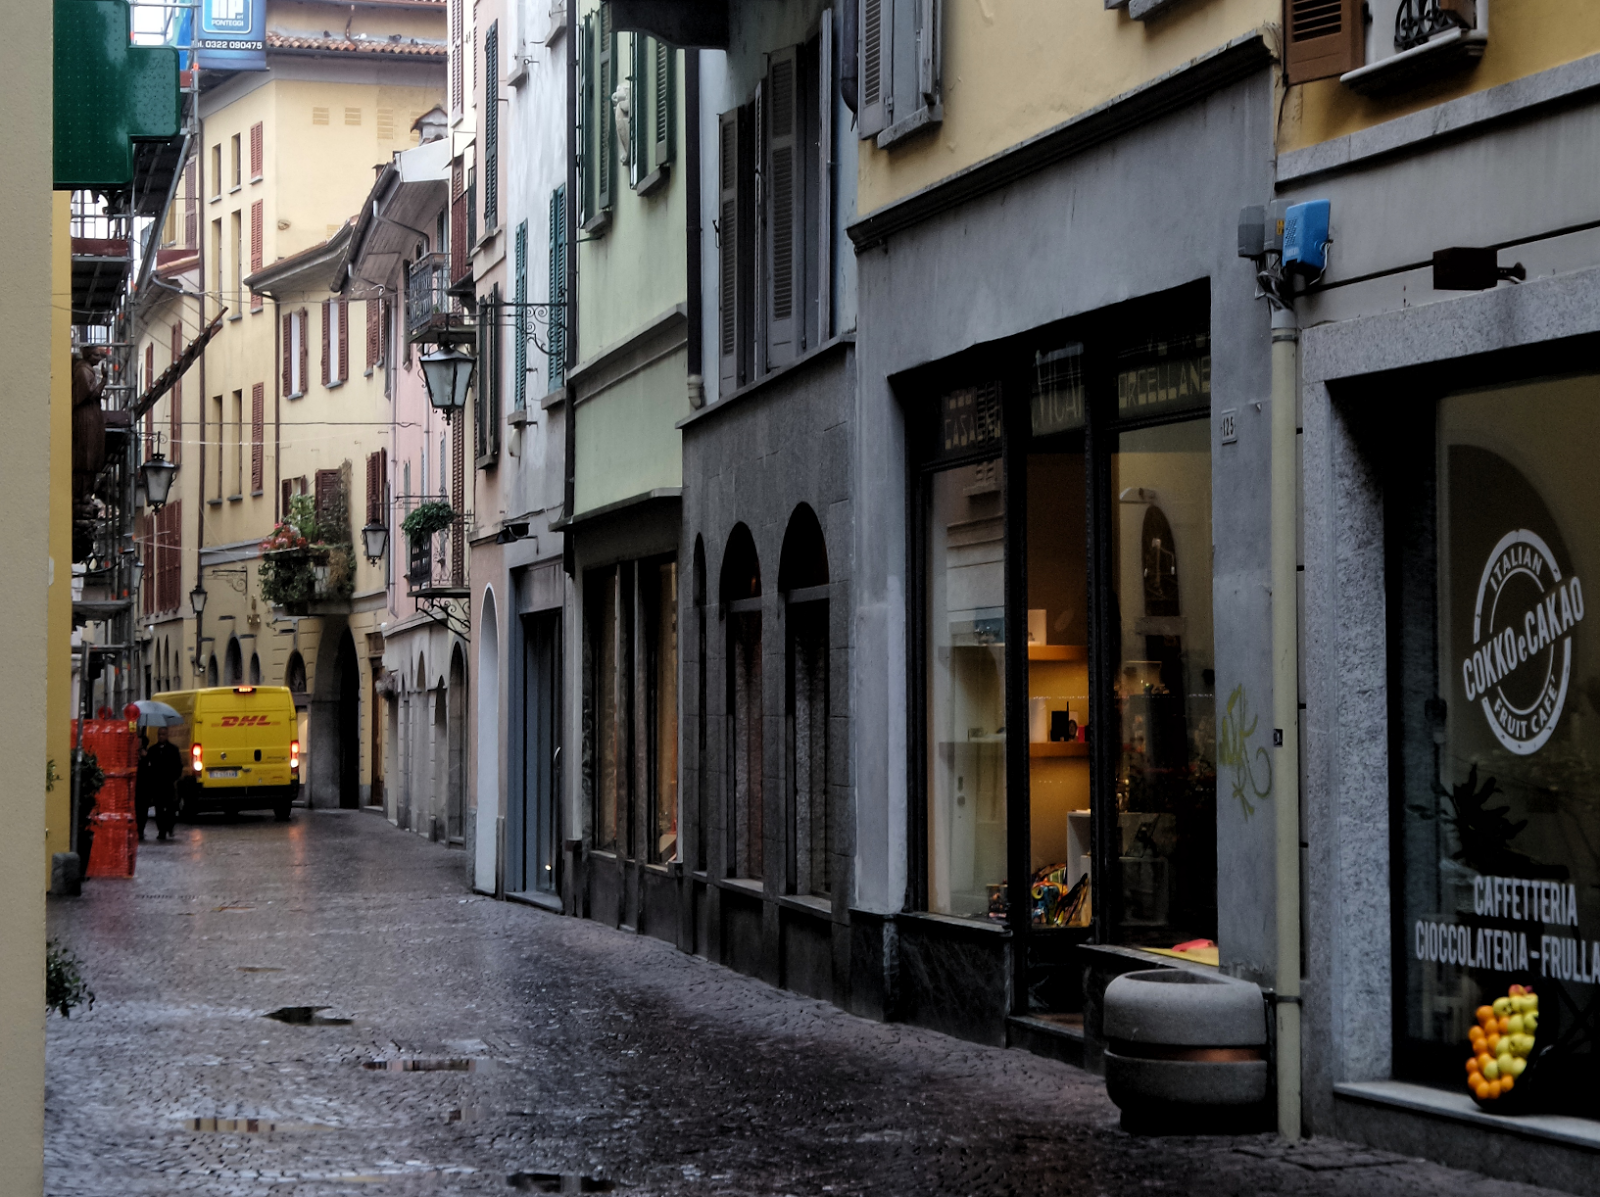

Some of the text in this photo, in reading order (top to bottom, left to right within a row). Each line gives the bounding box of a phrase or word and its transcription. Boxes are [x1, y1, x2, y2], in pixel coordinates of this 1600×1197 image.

[229, 41, 263, 49] 090475
[1118, 351, 1211, 409] ORCELLANE
[1223, 416, 1234, 437] 125
[1490, 546, 1543, 591] ITALIAN
[221, 715, 271, 727] DHL
[1493, 698, 1527, 739] FRUIT
[1474, 875, 1578, 926] CAFFETTERIA
